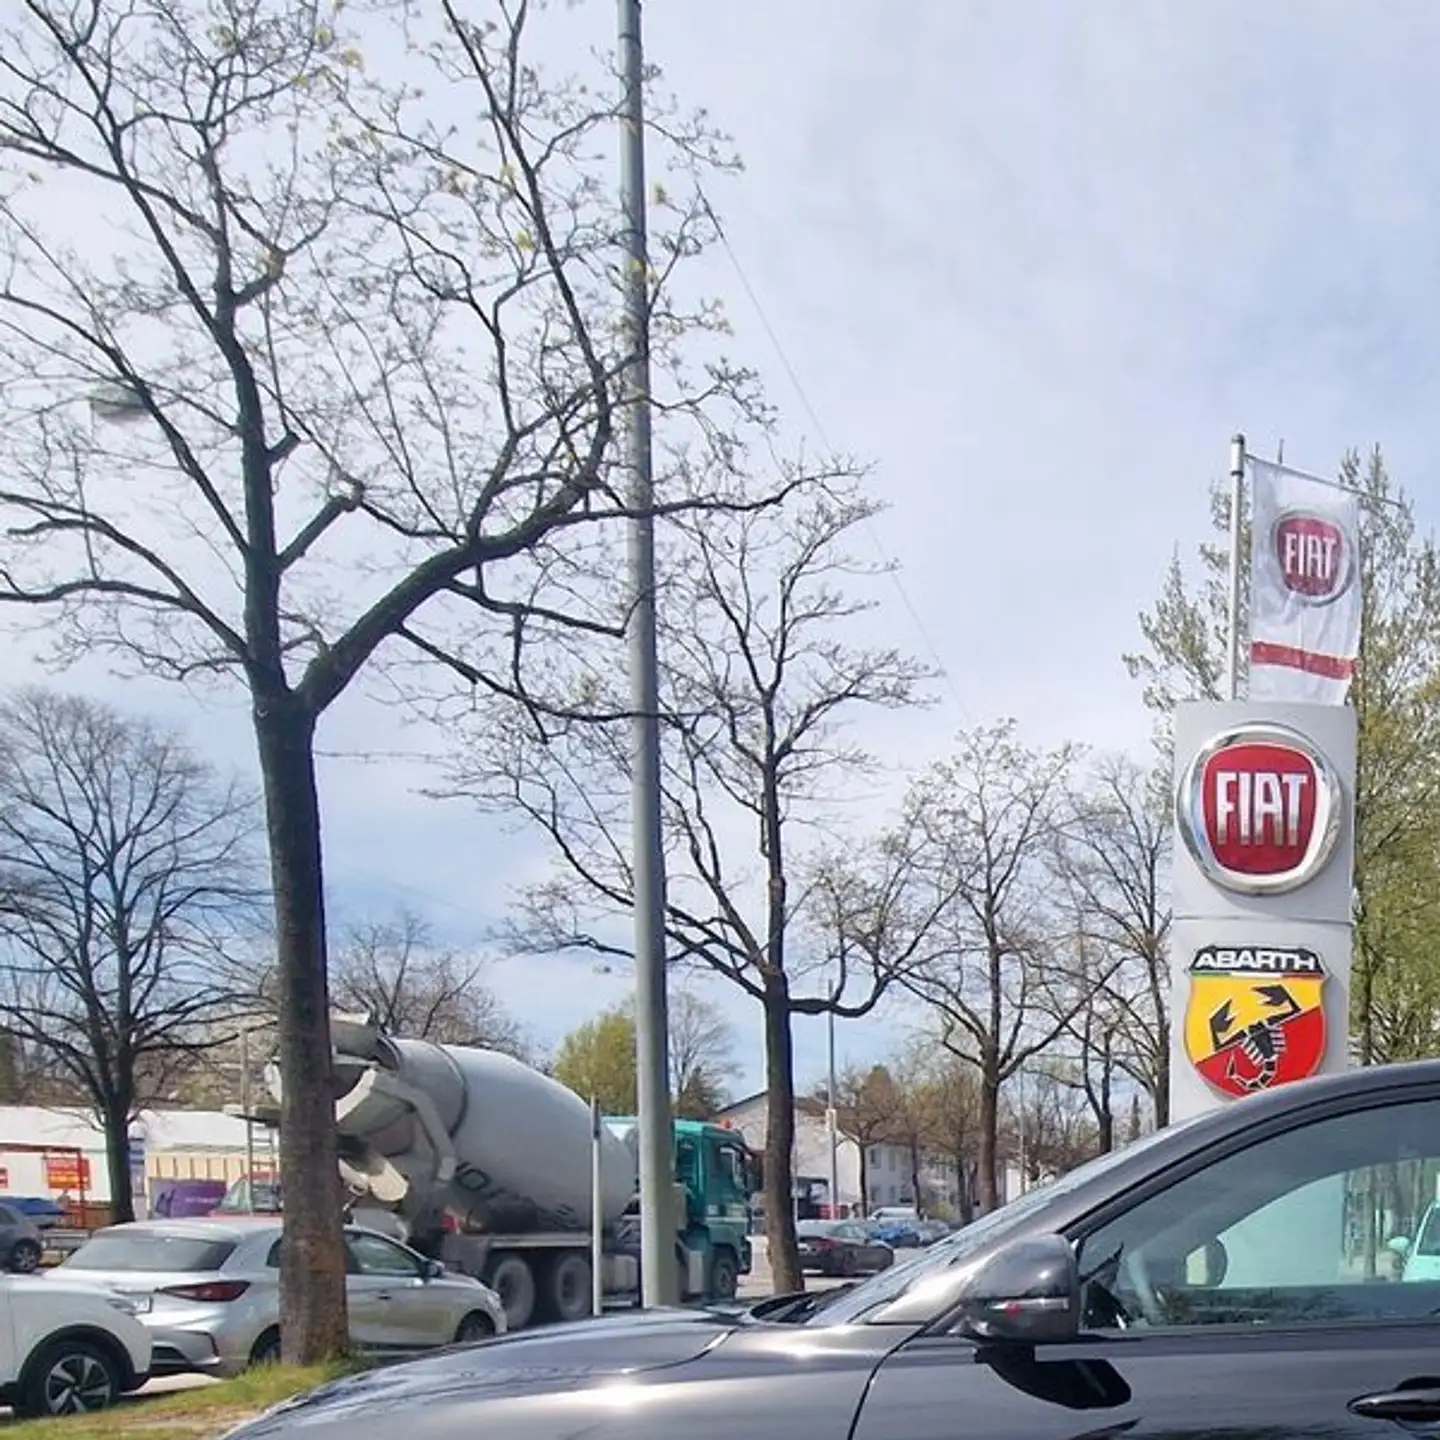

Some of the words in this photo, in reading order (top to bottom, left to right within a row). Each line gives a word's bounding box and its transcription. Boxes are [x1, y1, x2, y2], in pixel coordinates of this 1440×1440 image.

[1284, 532, 1338, 580] FIAT
[1216, 771, 1307, 847] FIAT
[1194, 949, 1316, 971] ABARTH
